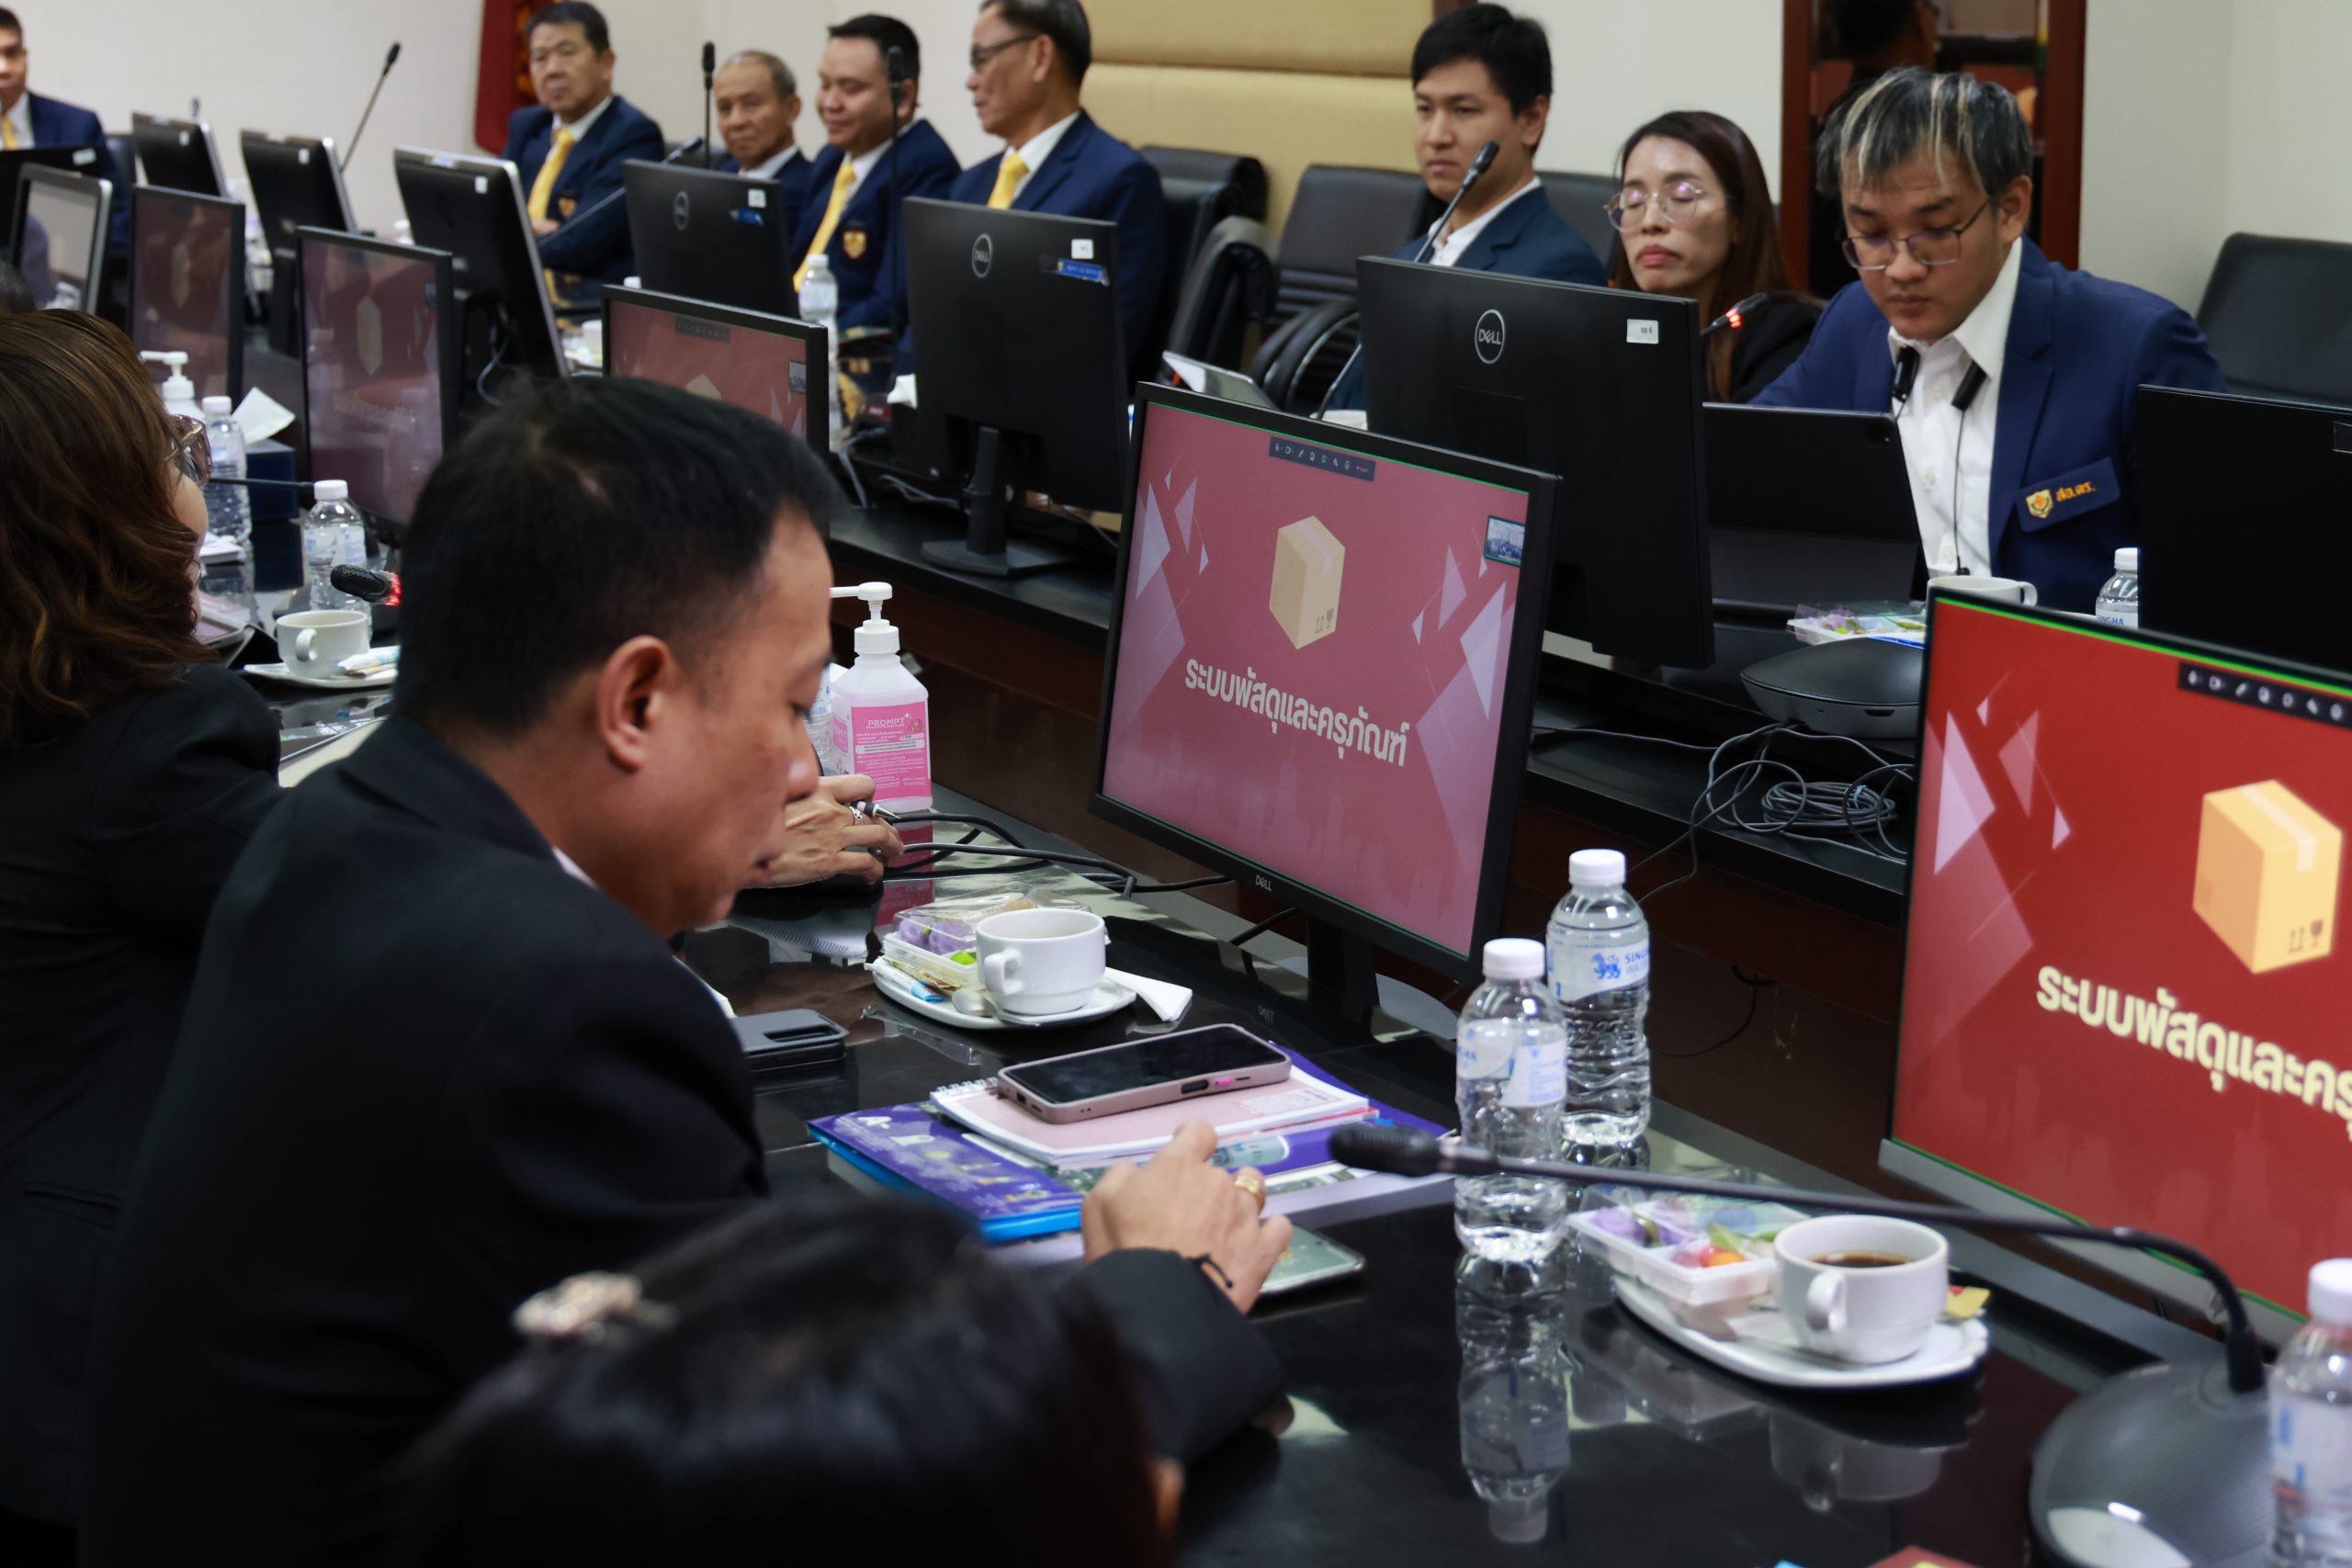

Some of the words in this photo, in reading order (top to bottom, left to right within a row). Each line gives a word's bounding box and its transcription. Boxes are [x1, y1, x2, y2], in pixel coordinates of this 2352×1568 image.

[1478, 328, 1501, 345] DELL
[1648, 325, 1654, 334] 6
[1184, 658, 1411, 768] ระบบพัสดุและครุภัณฑ์
[867, 717, 906, 728] PROMPT
[1255, 874, 1272, 891] DELL
